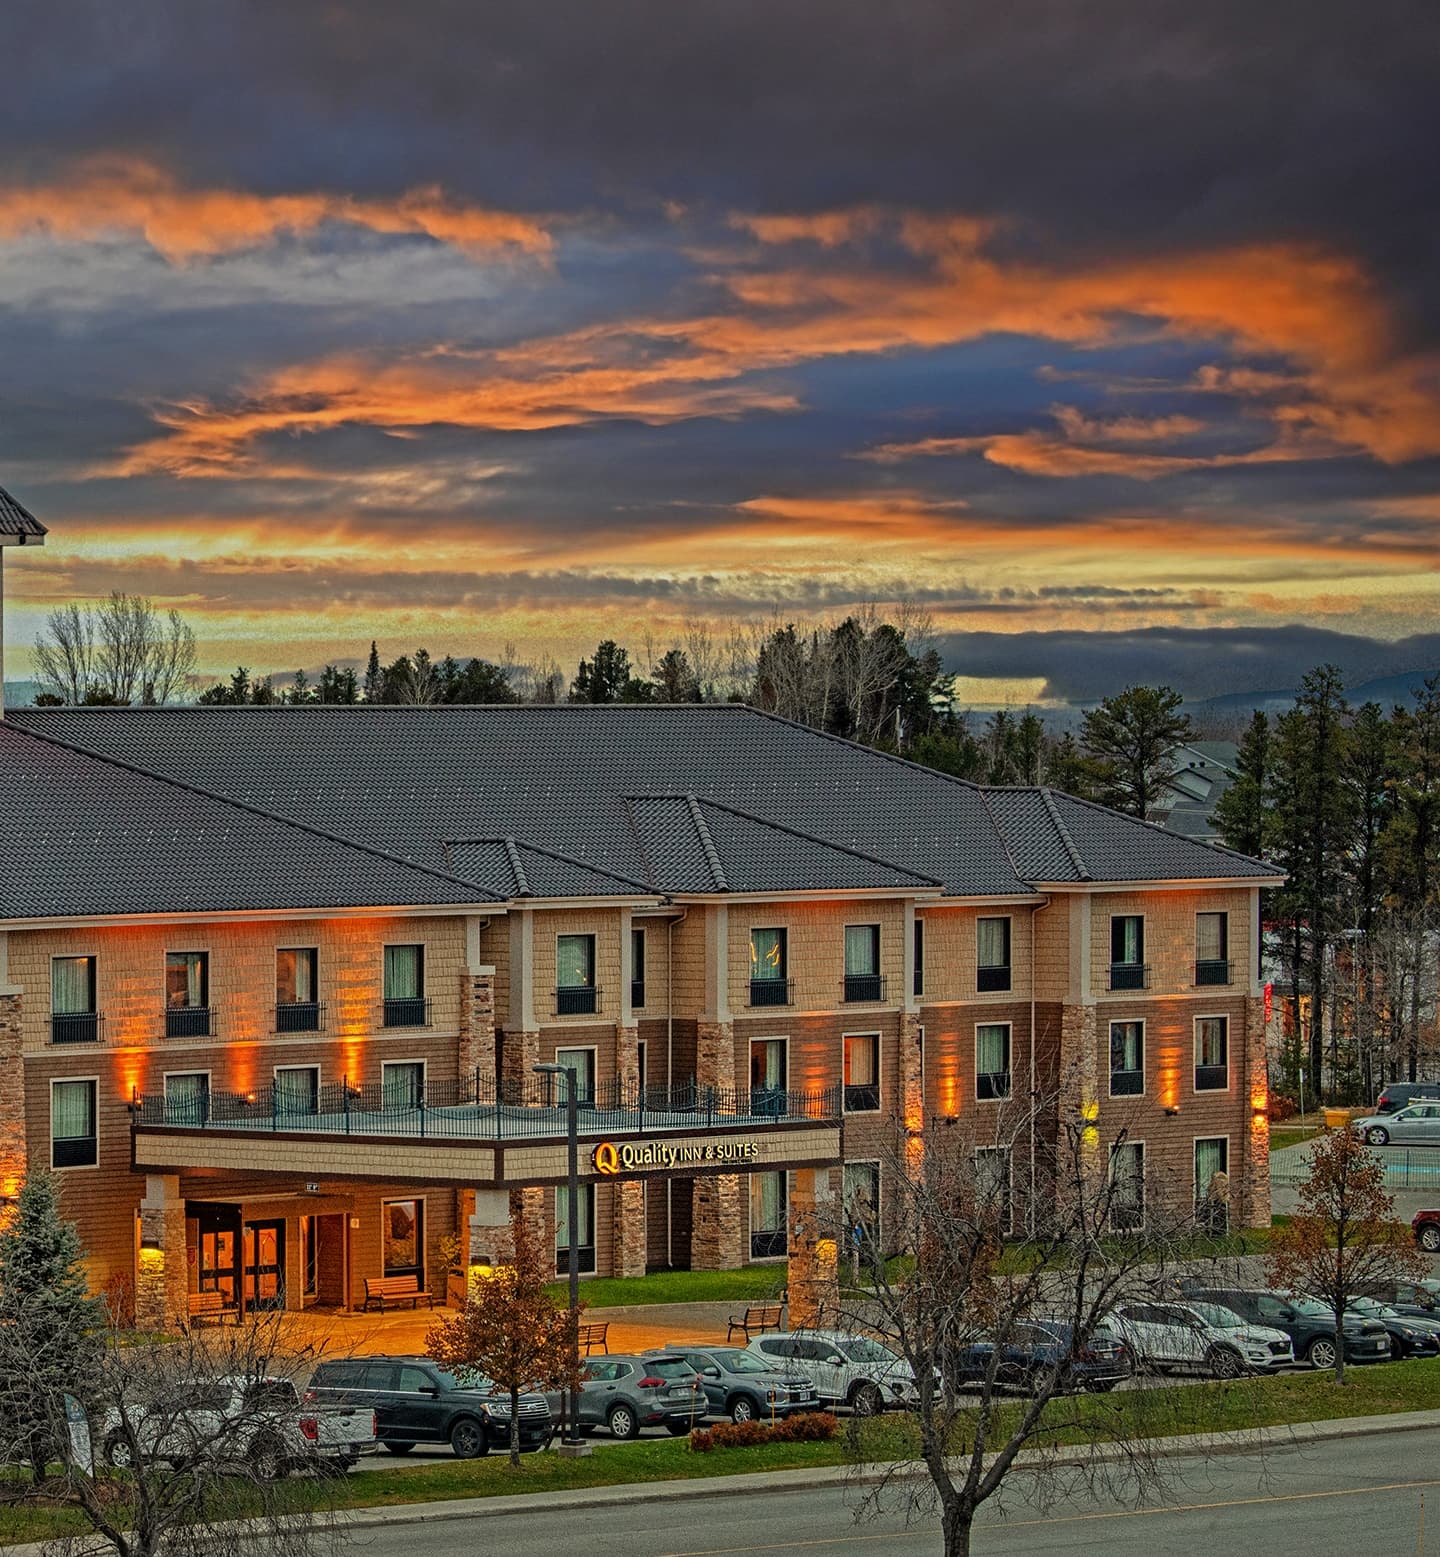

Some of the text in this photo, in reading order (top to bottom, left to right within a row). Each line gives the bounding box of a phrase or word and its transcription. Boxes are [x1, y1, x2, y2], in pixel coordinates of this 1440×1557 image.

[622, 1143, 677, 1169] Quality
[680, 1147, 702, 1161] INN
[705, 1146, 713, 1159] &
[716, 1143, 759, 1158] SUITES
